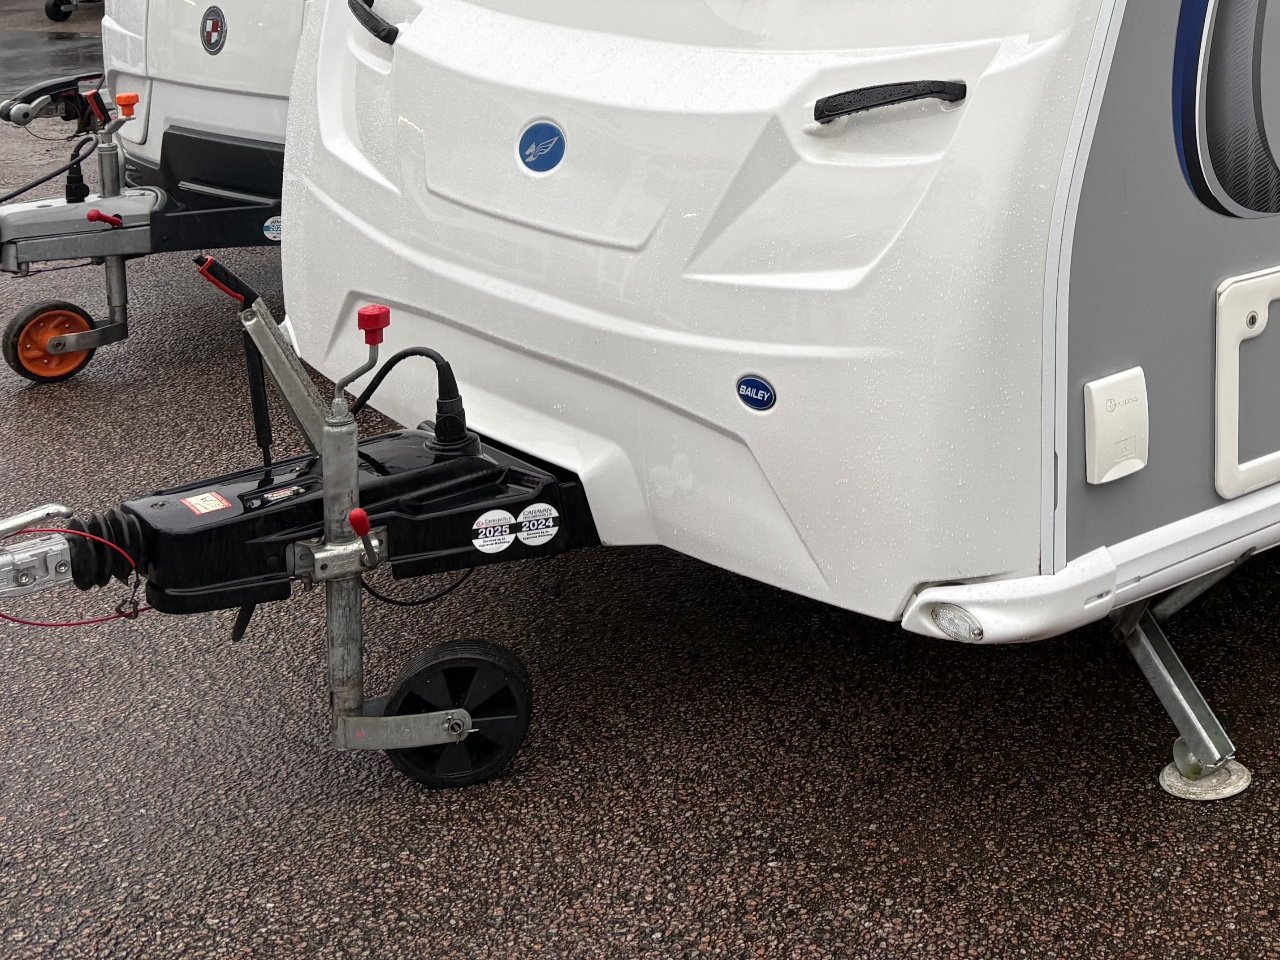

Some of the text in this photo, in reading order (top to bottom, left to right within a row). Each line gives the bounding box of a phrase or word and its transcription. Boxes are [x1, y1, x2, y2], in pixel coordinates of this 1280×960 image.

[739, 384, 771, 402] BAILEY
[477, 525, 510, 539] 2025
[521, 518, 554, 532] 2024
